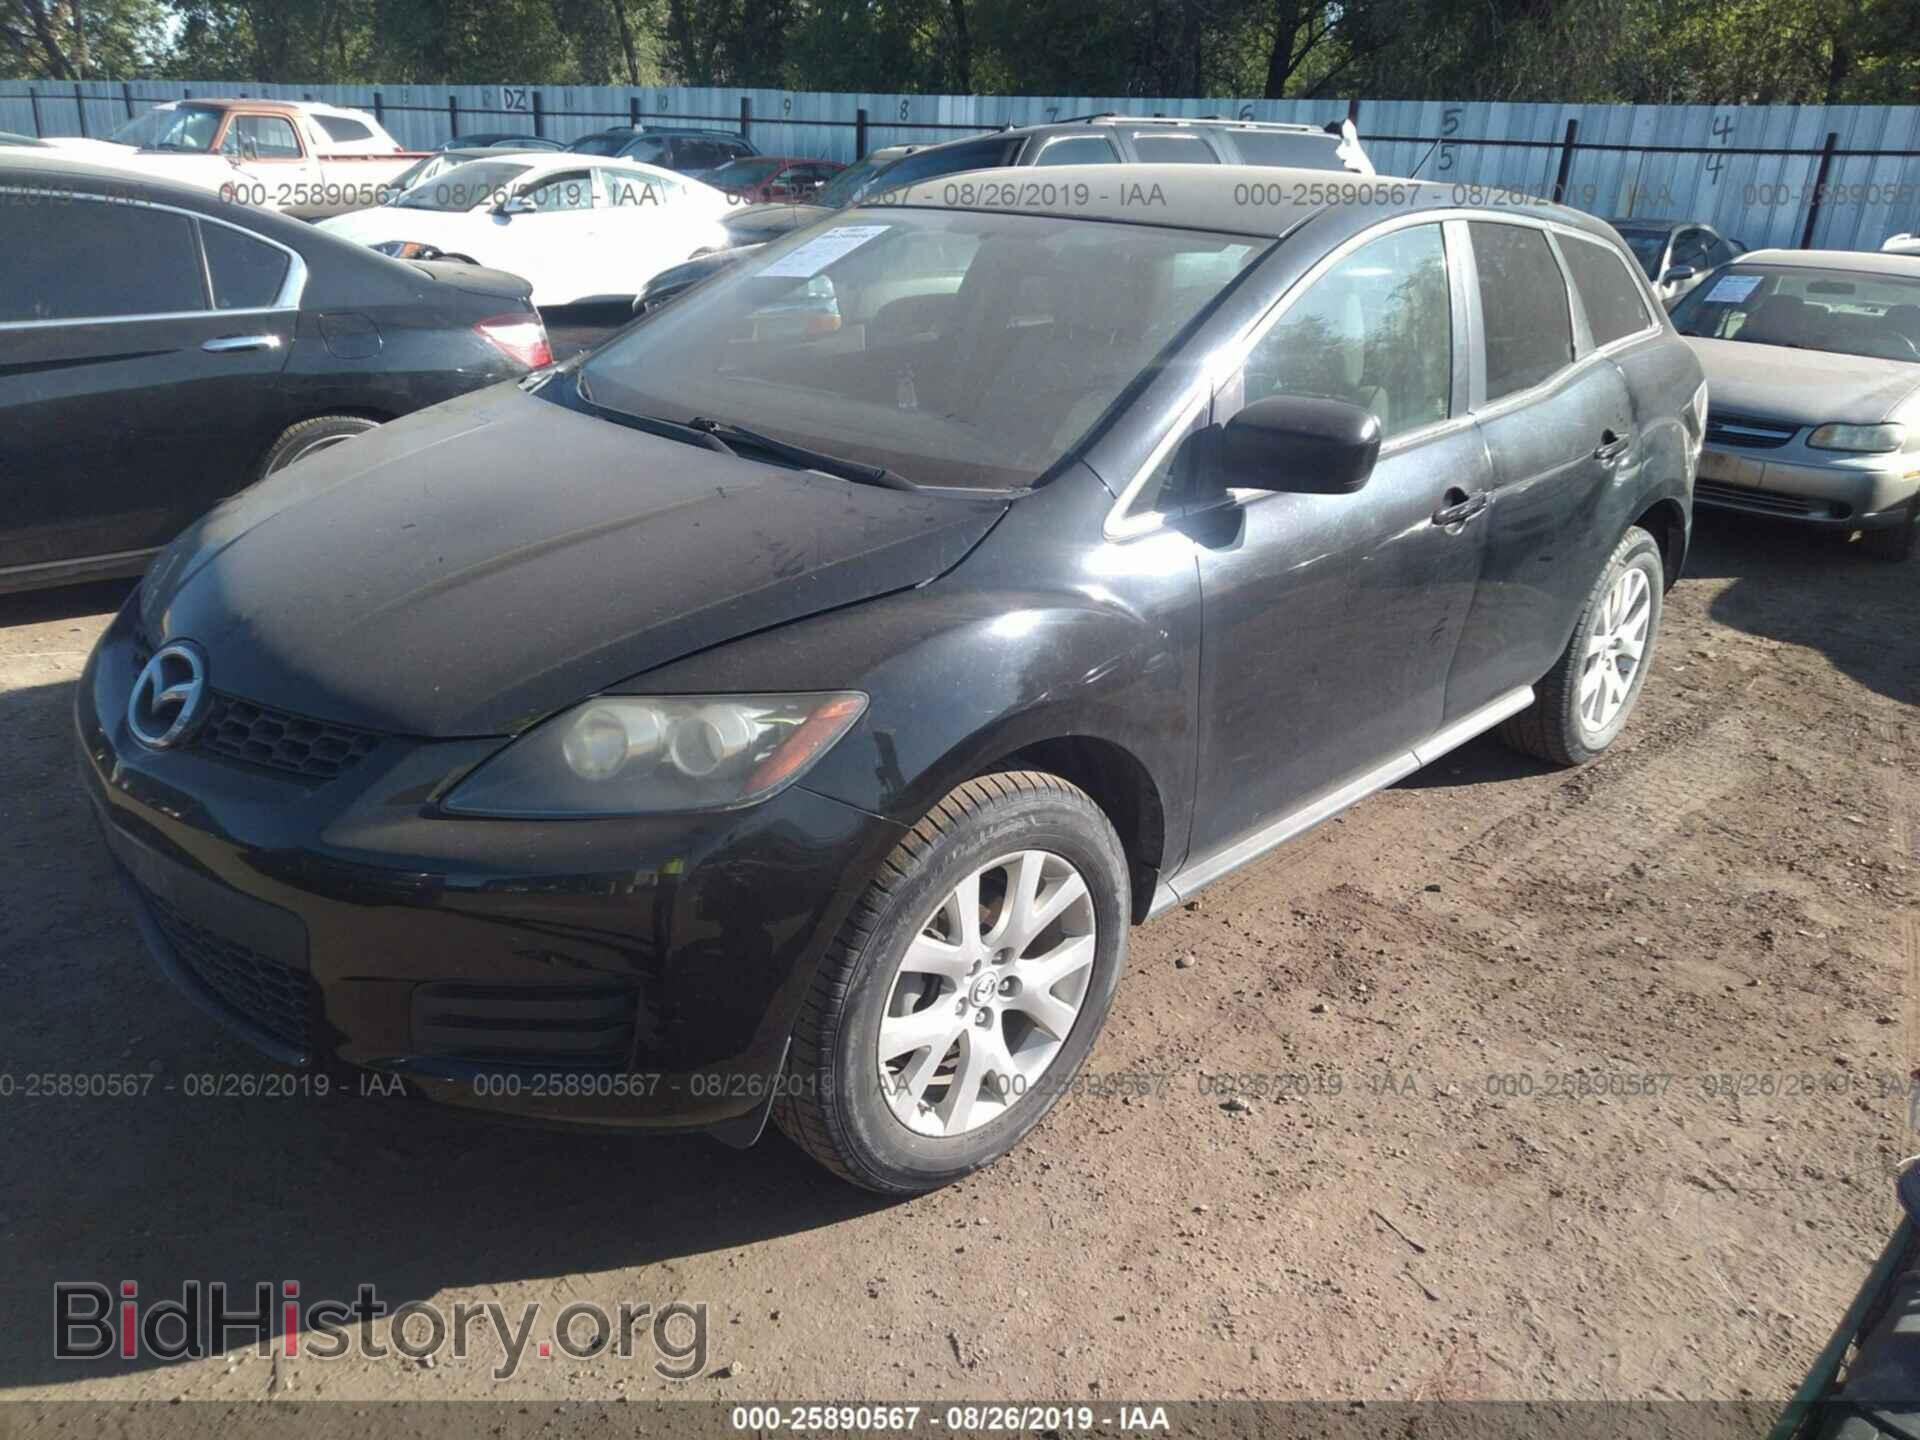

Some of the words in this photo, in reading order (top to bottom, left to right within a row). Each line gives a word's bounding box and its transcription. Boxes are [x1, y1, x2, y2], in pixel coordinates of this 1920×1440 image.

[782, 97, 792, 117] 9
[898, 97, 912, 121] 8
[1440, 108, 1464, 135] 5
[1712, 114, 1734, 145] 4
[1437, 145, 1457, 171] 5
[1705, 153, 1724, 185] 4
